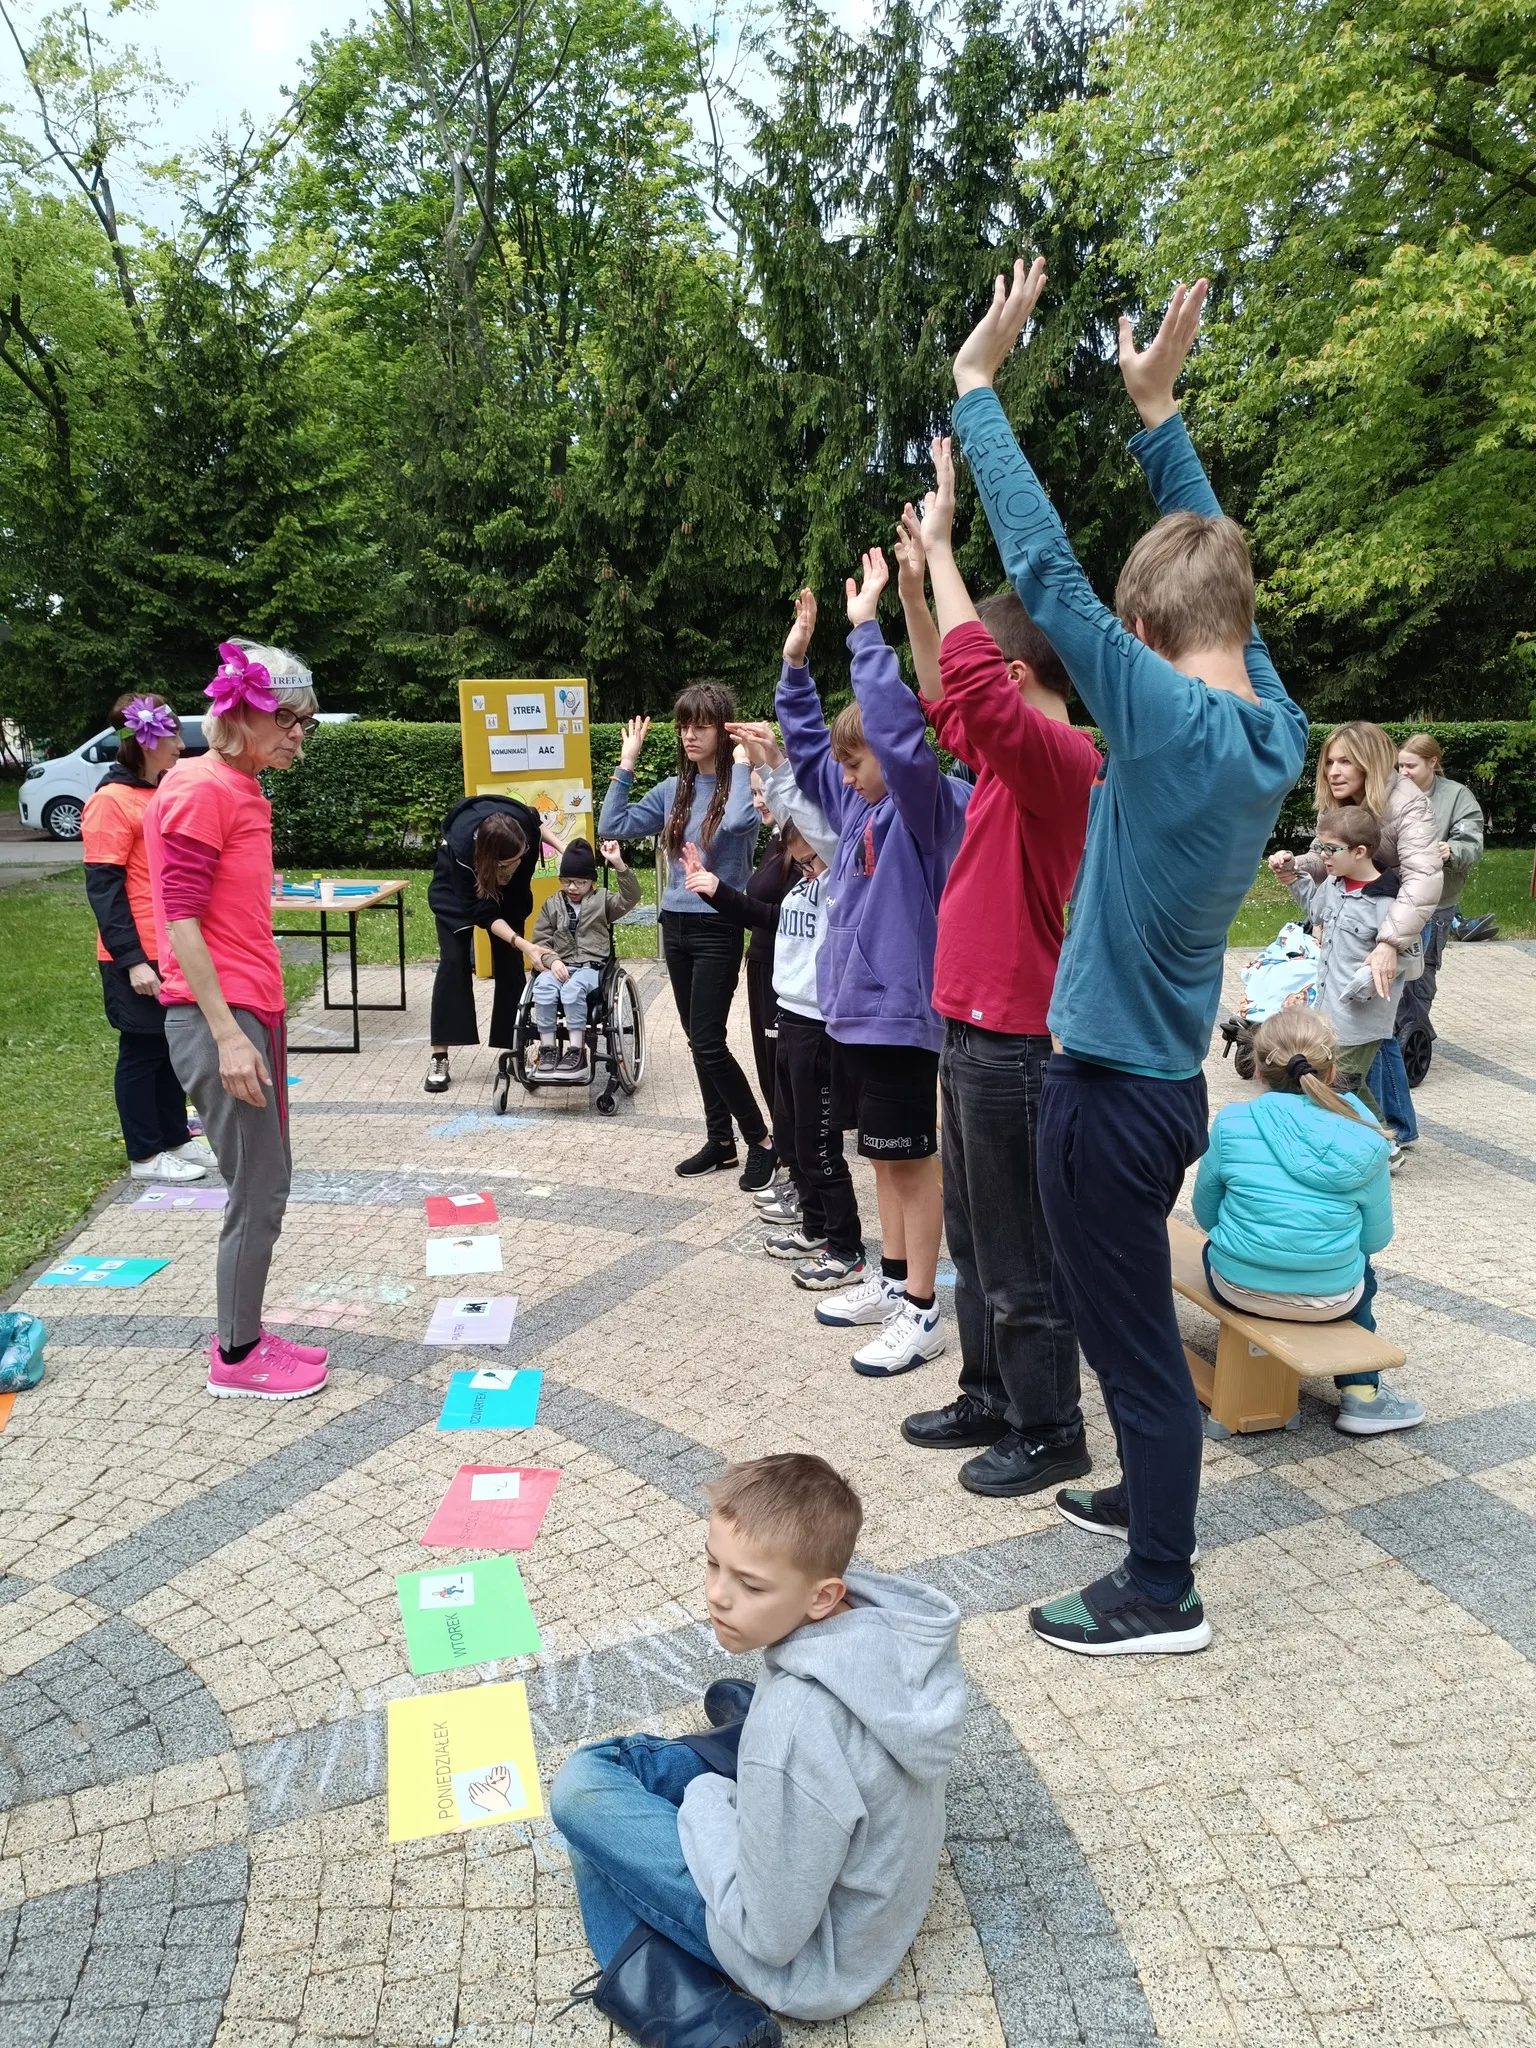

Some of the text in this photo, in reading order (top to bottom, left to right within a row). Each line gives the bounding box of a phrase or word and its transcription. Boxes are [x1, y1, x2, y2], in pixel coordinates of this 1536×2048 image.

[271, 676, 303, 685] TREFA
[513, 705, 541, 715] STREFA
[538, 745, 555, 755] AAC
[779, 907, 817, 939] NOIS
[764, 1027, 779, 1038] PUM
[819, 1086, 831, 1137] MAKER
[863, 1134, 911, 1149] kipsta
[469, 1391, 487, 1424] CZWARTEK
[444, 1612, 467, 1659] WTOREK
[433, 1720, 454, 1820] PONIEDZIAŁEK
